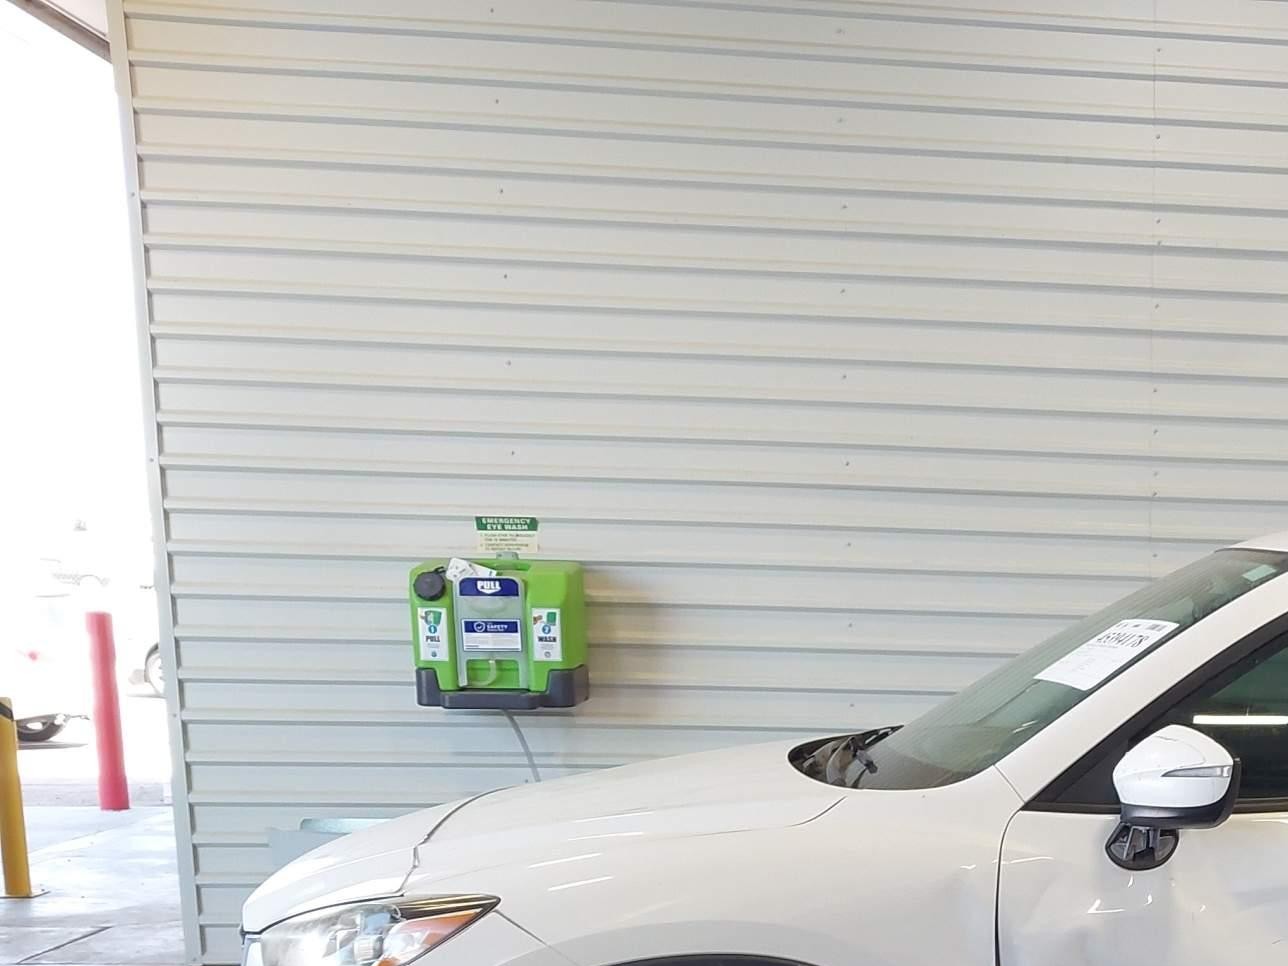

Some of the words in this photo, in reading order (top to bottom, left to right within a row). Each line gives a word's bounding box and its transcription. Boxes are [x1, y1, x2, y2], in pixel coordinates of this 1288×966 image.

[477, 581, 501, 590] PULL
[425, 635, 441, 643] PULL
[537, 635, 557, 643] WASH
